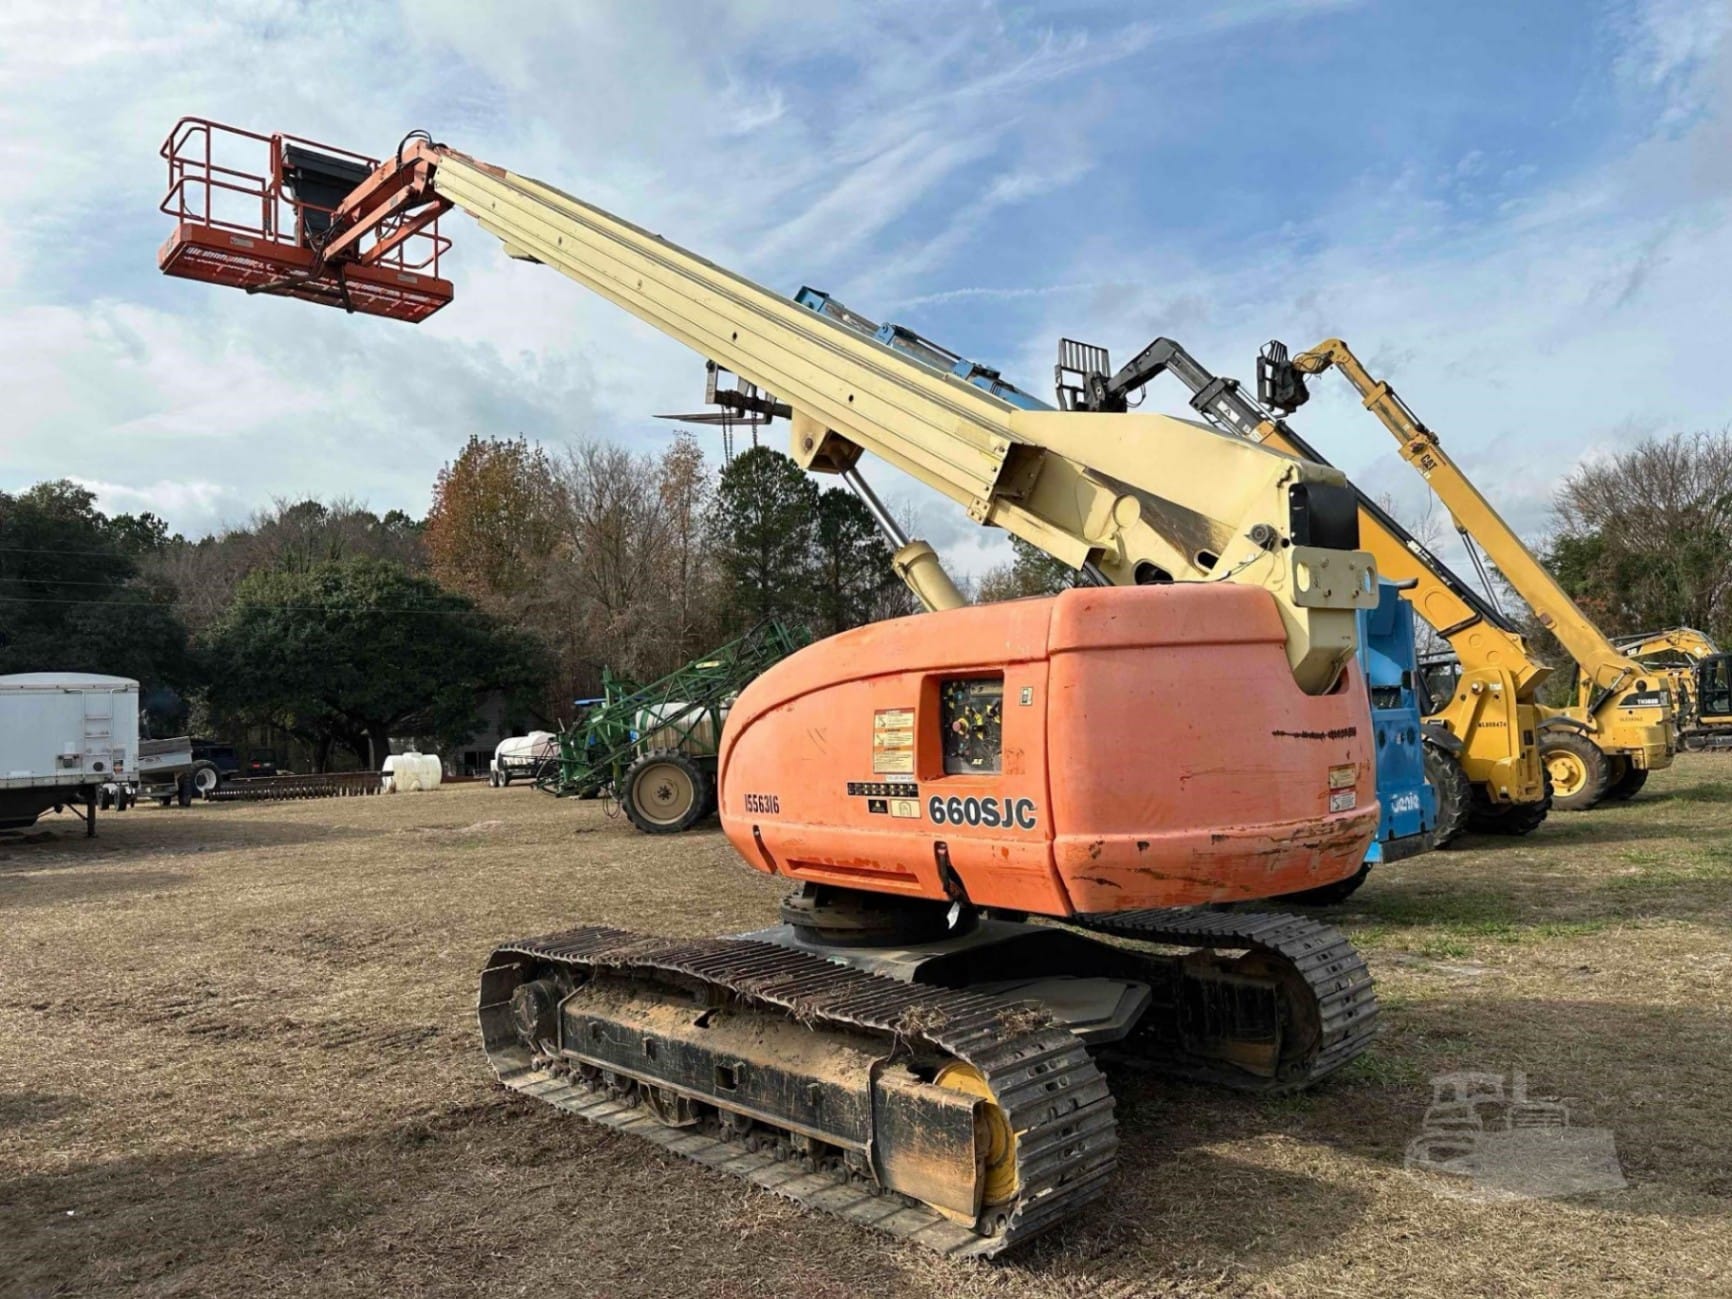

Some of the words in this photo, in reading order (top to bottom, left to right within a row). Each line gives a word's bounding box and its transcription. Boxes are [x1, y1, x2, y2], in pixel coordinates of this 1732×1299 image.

[1420, 454, 1438, 471] CAT
[744, 794, 780, 814] 1556316
[929, 794, 1037, 830] 660SJC
